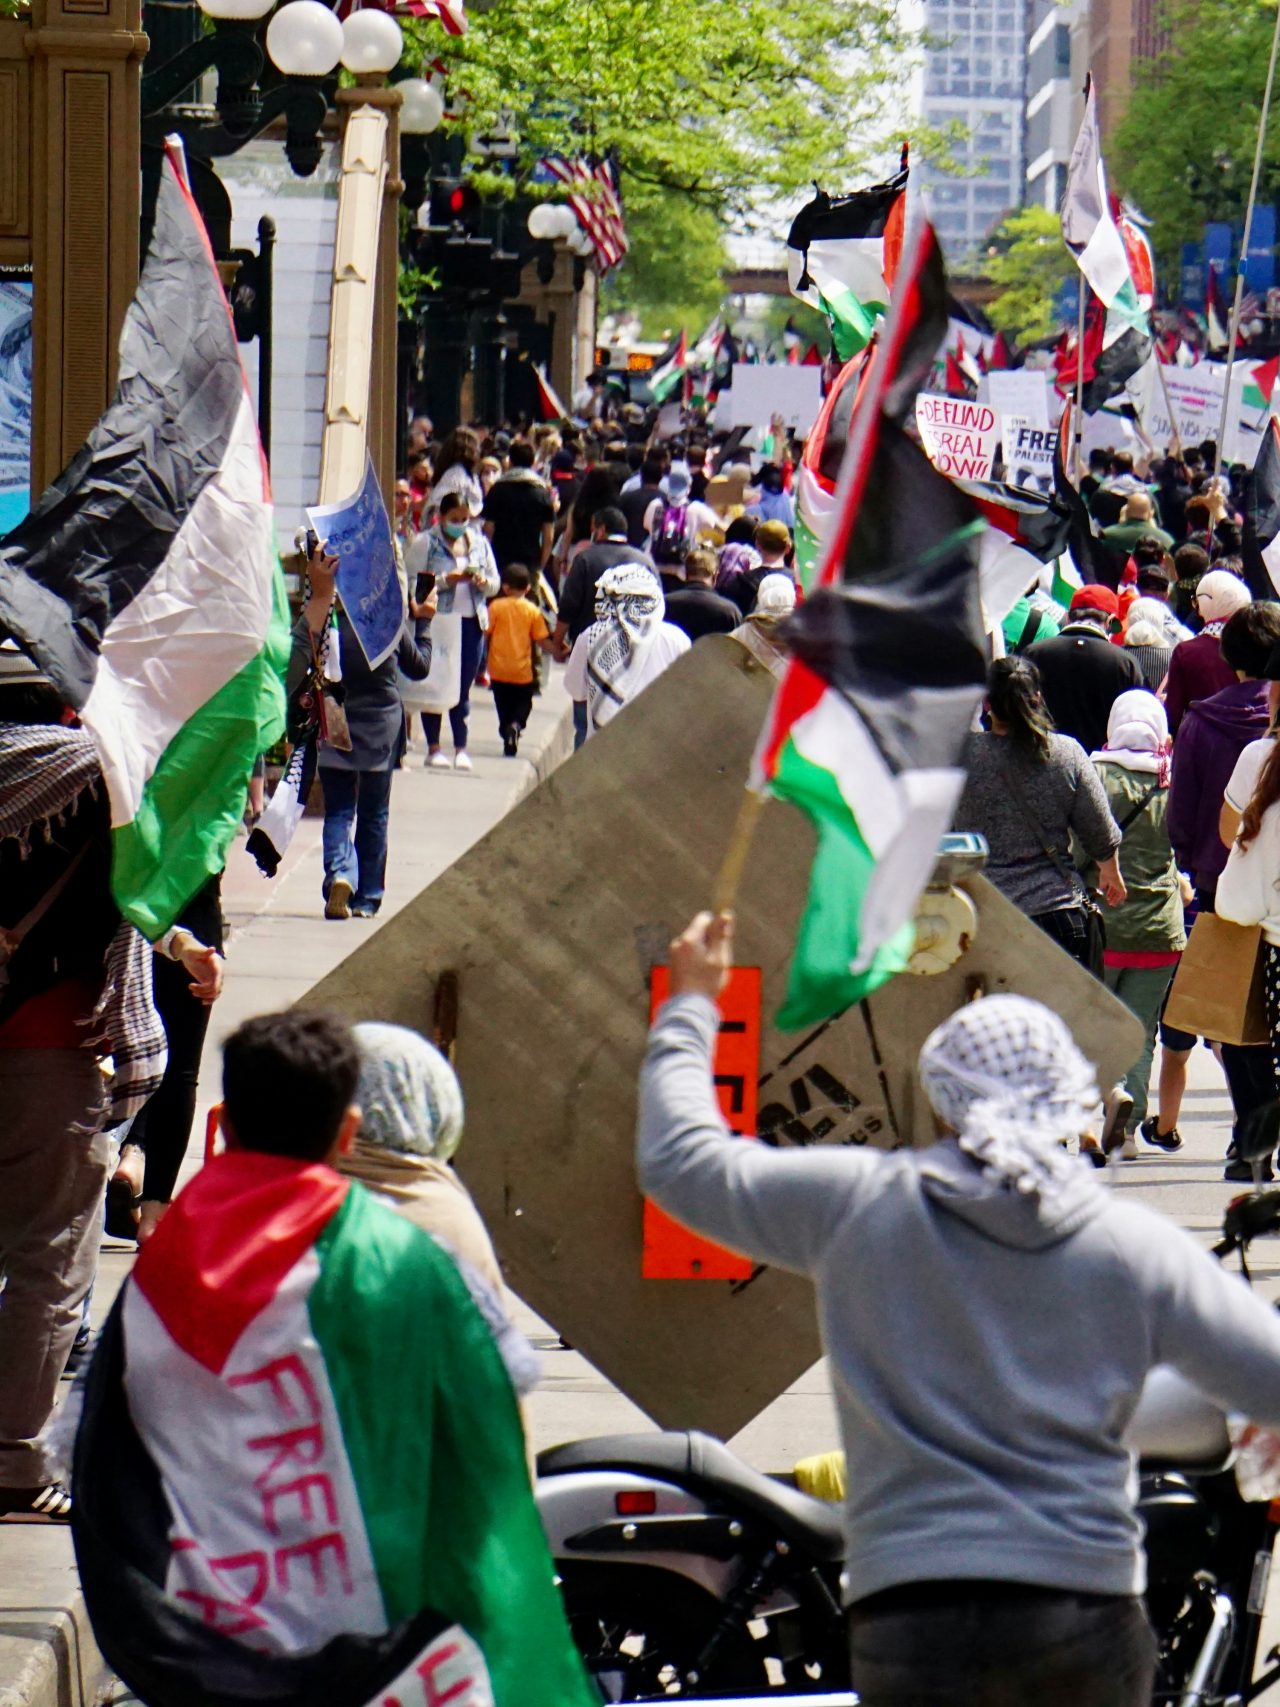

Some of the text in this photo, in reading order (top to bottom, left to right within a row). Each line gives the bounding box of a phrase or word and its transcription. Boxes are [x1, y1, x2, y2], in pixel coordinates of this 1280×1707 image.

[1016, 428, 1058, 451] FRE
[1014, 449, 1054, 464] PALEST
[227, 1353, 355, 1597] FREE
